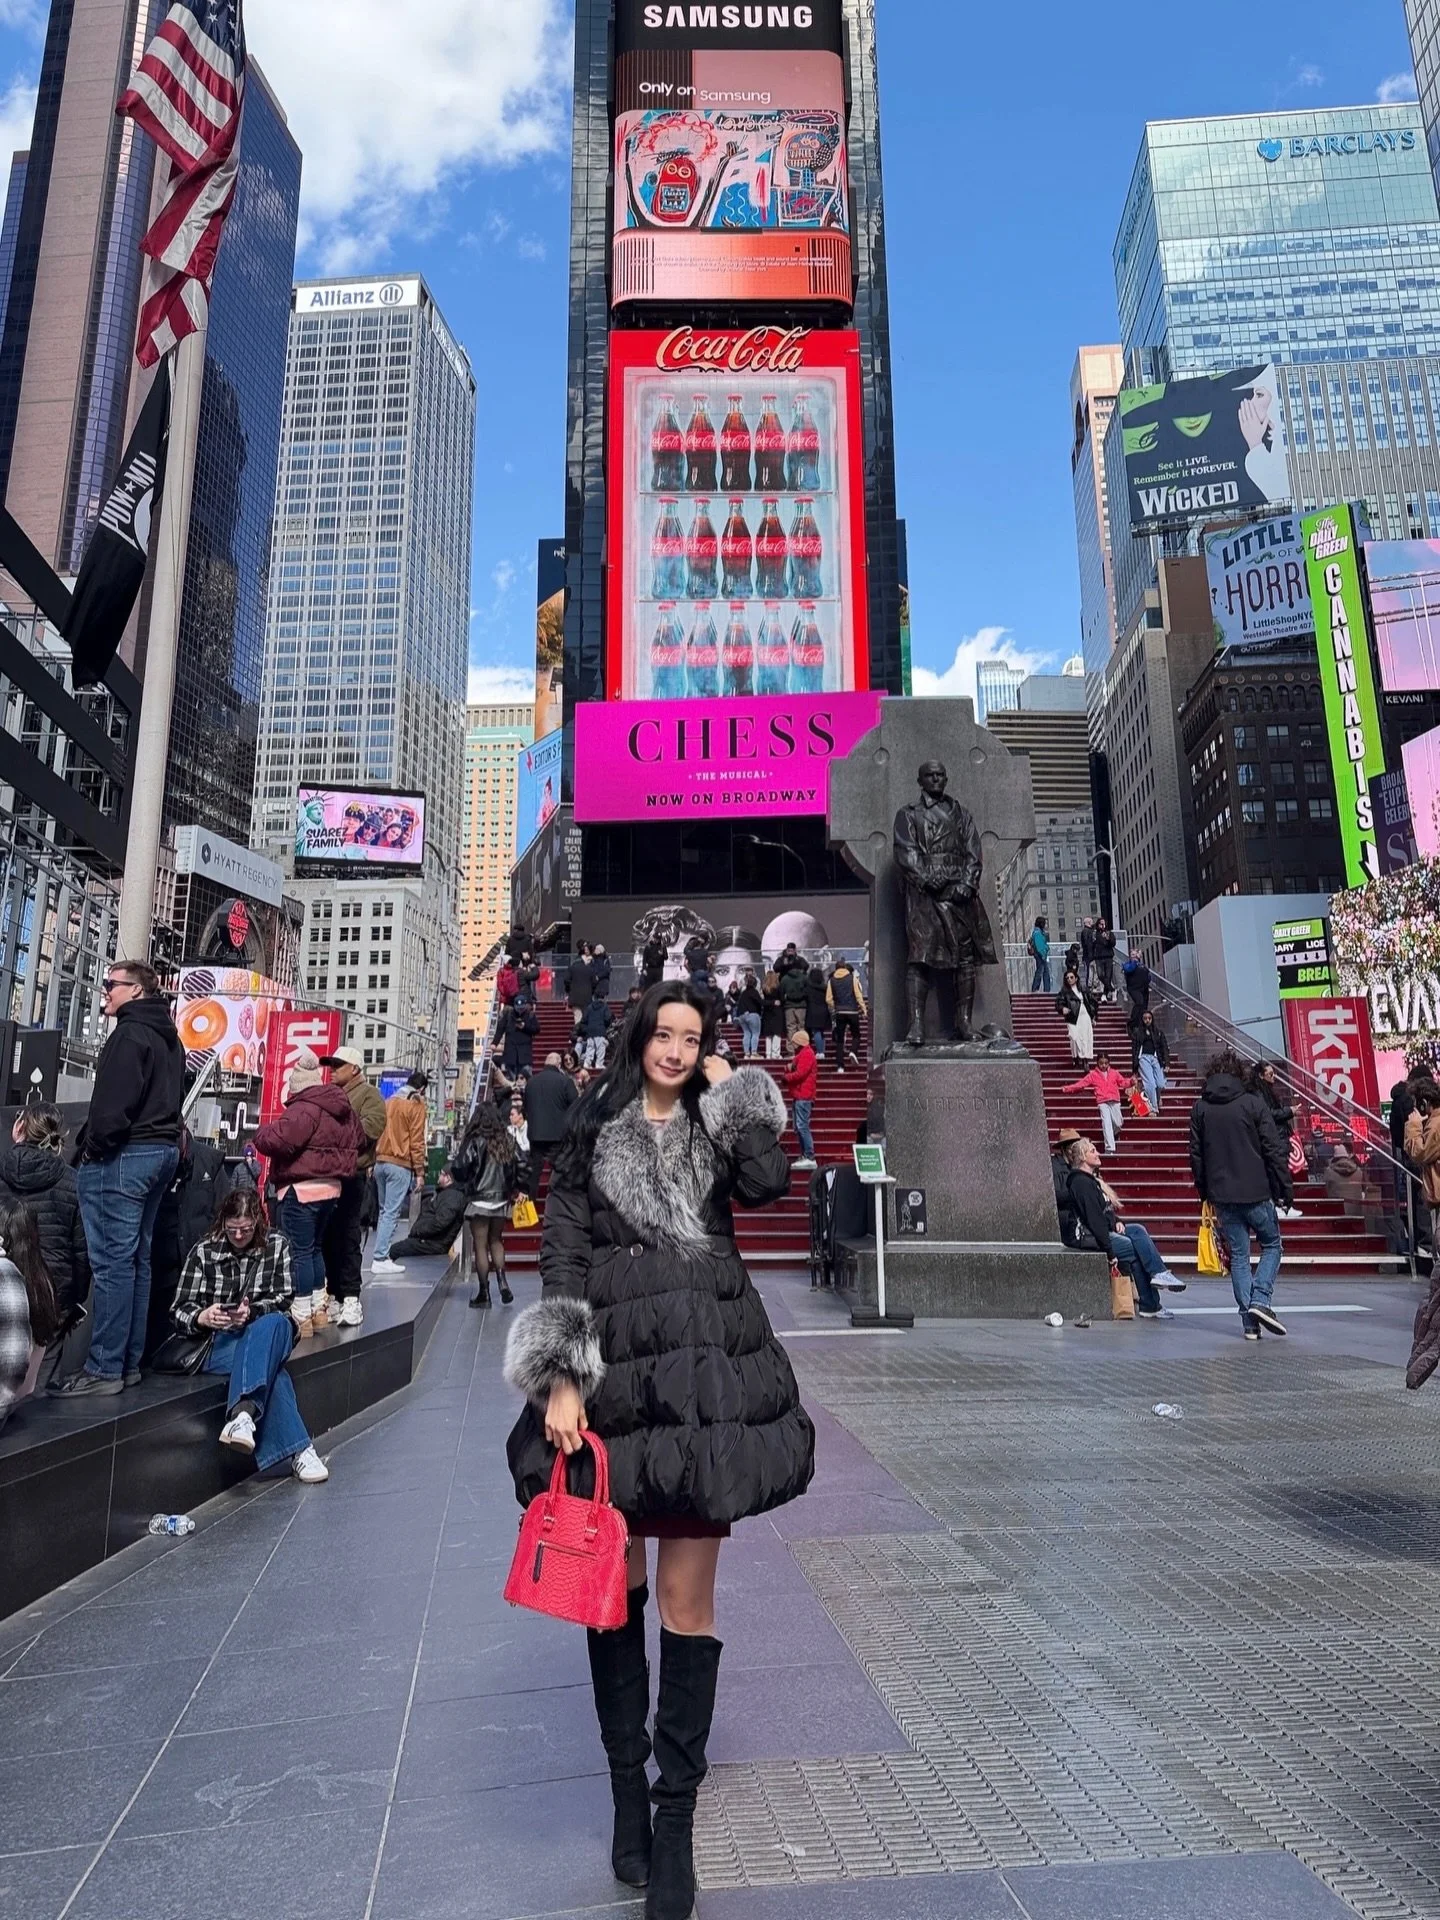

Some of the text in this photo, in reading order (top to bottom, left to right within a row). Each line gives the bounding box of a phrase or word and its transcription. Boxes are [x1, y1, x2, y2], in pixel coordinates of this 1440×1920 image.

[643, 5, 813, 28] SAMSUNG
[639, 82, 772, 104] Only on Samsung
[1289, 129, 1417, 158] BARCLAYS
[310, 289, 375, 307] Allianz
[1133, 461, 1238, 485] Remember it FOREVER.
[1158, 455, 1210, 471] See it LIVE.
[1222, 520, 1295, 570] LITTLE
[1309, 524, 1338, 549] DAILY
[1278, 547, 1293, 558] OF
[1315, 535, 1348, 560] GREEN
[1243, 630, 1272, 640] Westside
[1274, 625, 1297, 634] Theatre
[1324, 562, 1375, 830] CANNABIS
[1385, 694, 1424, 704] KEVANI
[627, 711, 836, 764] CHESS
[696, 770, 767, 781] THE MUSICAL
[646, 789, 817, 807] NOW ON BROADWAY
[306, 827, 348, 838] SUAREZ
[306, 838, 346, 849] FAMILY
[213, 852, 278, 890] HYATT REGENCY
[1273, 924, 1311, 938] DAILY GREEN
